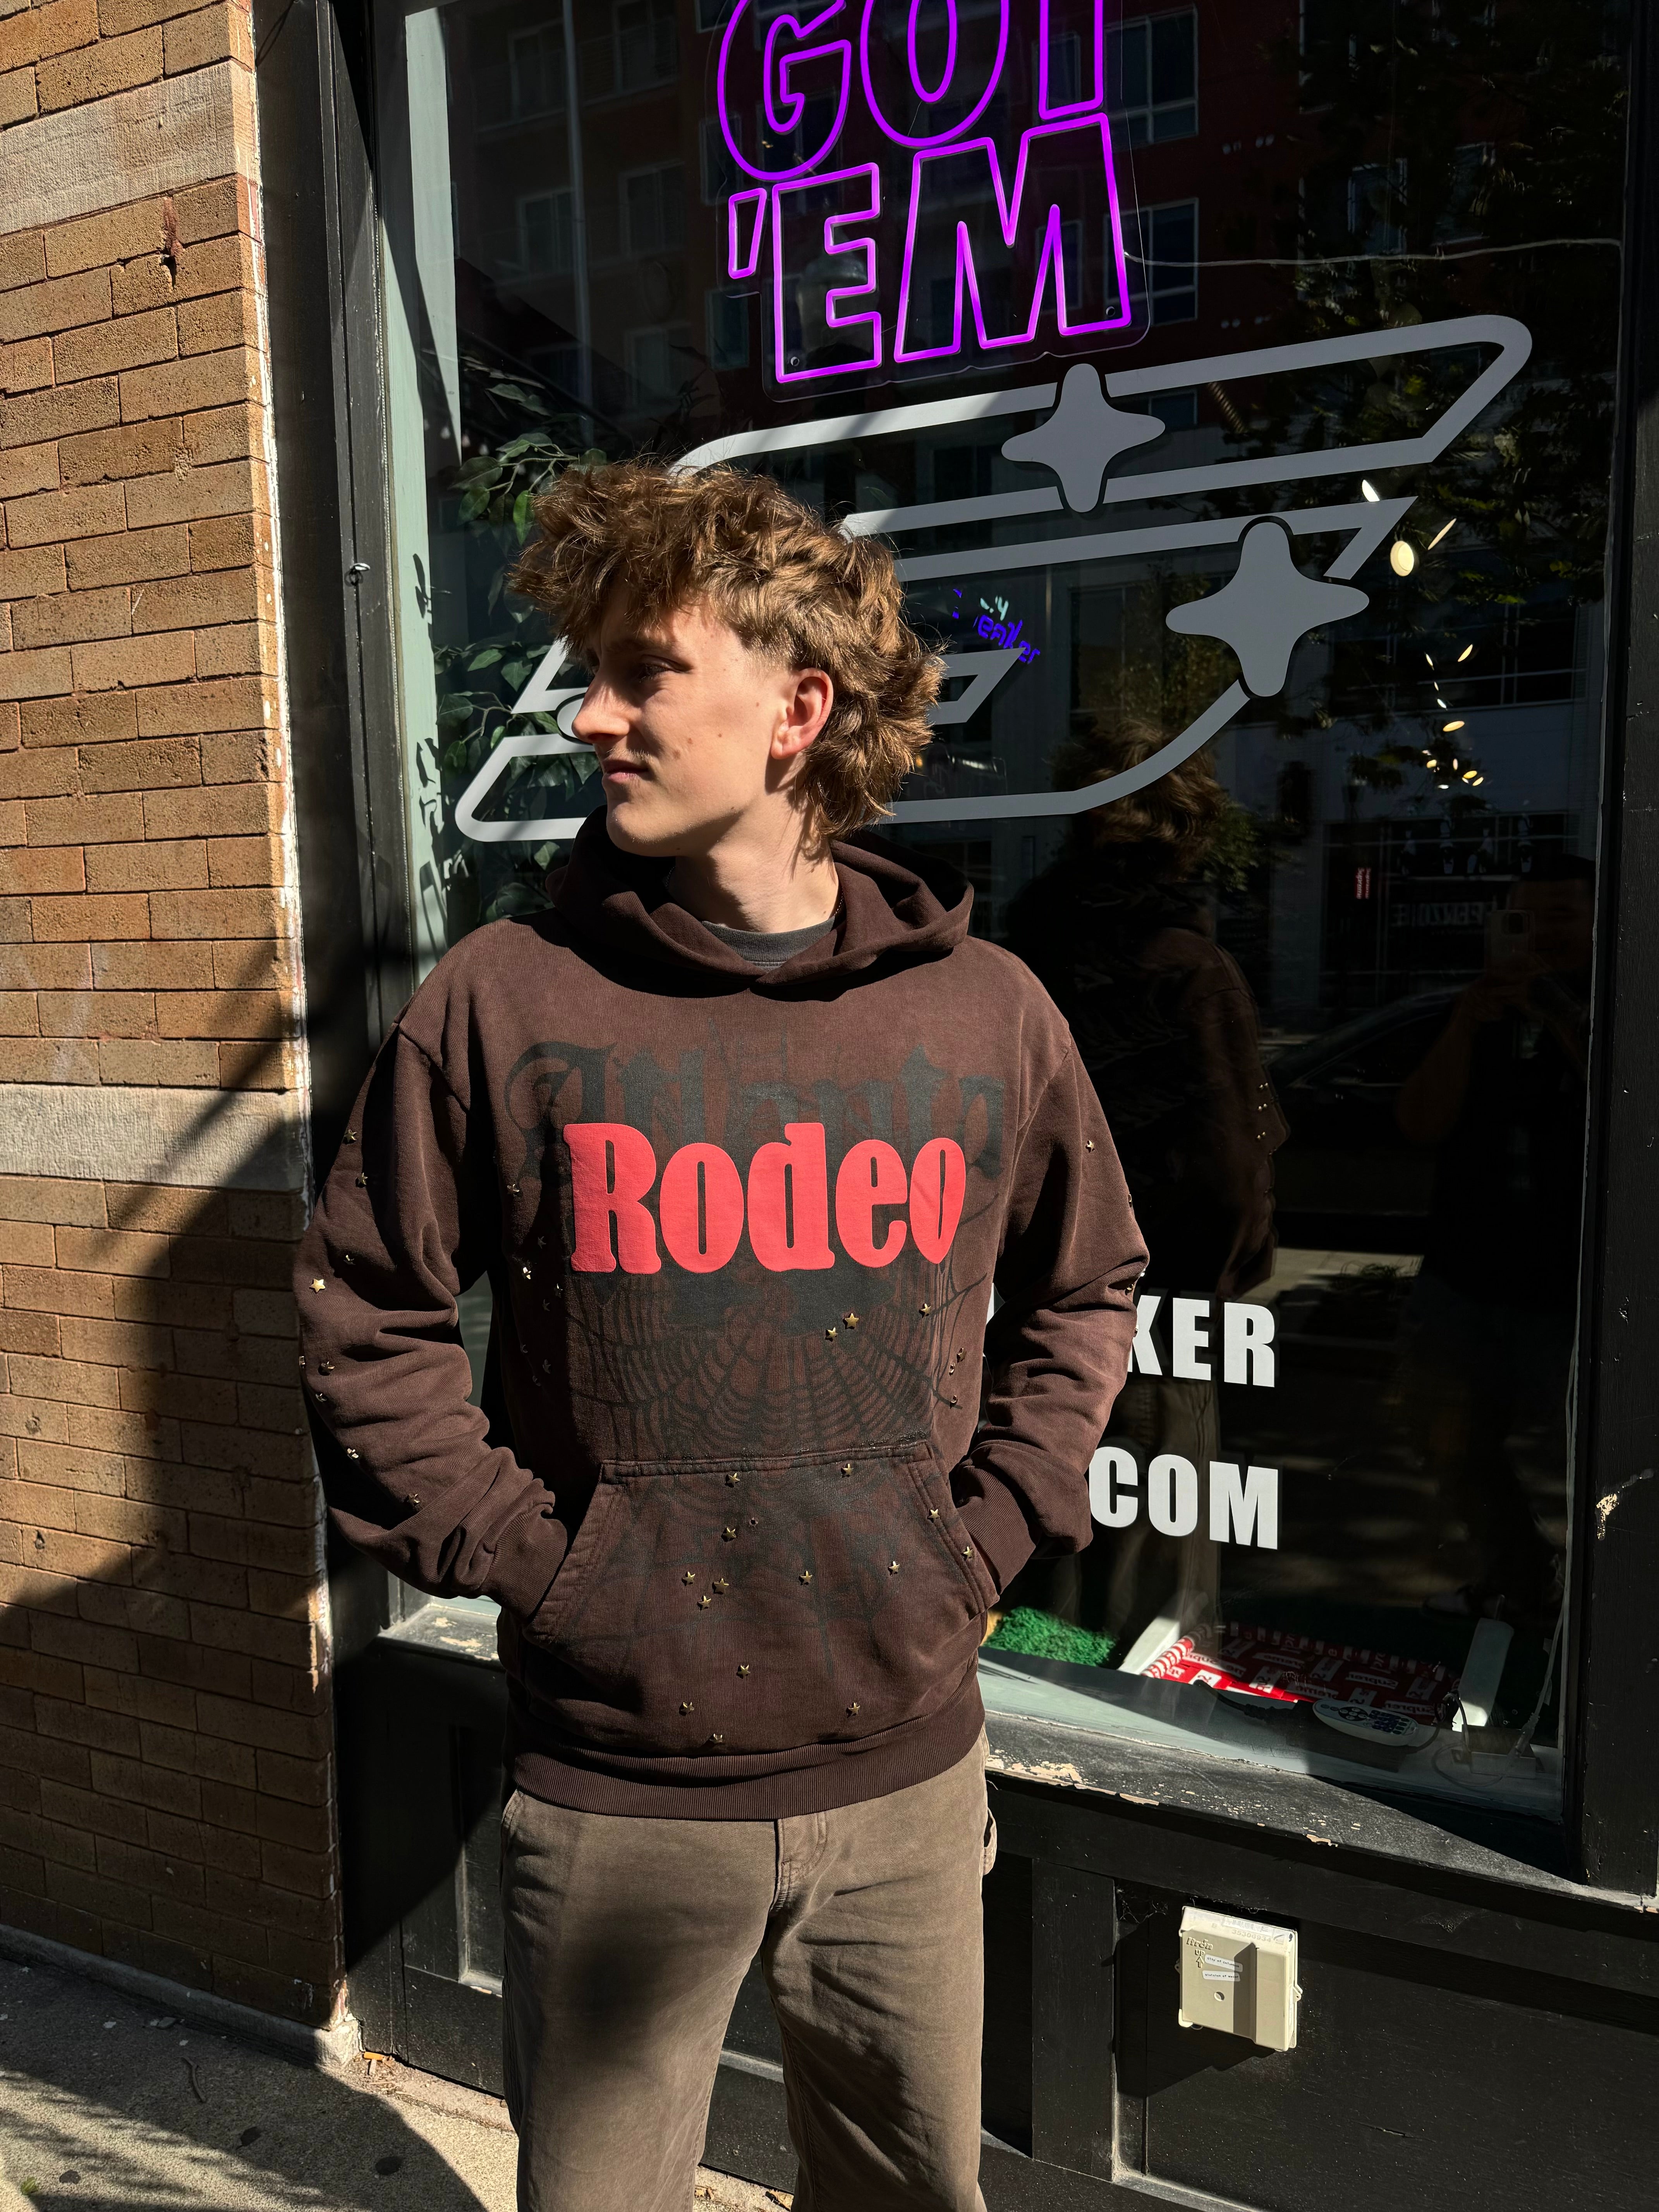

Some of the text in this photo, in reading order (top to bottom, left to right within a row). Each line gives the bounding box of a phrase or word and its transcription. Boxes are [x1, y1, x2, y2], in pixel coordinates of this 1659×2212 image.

[728, 112, 1132, 383] 'EM
[973, 615, 1041, 663] eaker
[563, 1123, 966, 1274] Rodeo
[1128, 1295, 1275, 1388] KER
[1187, 1937, 1213, 1950] Itron
